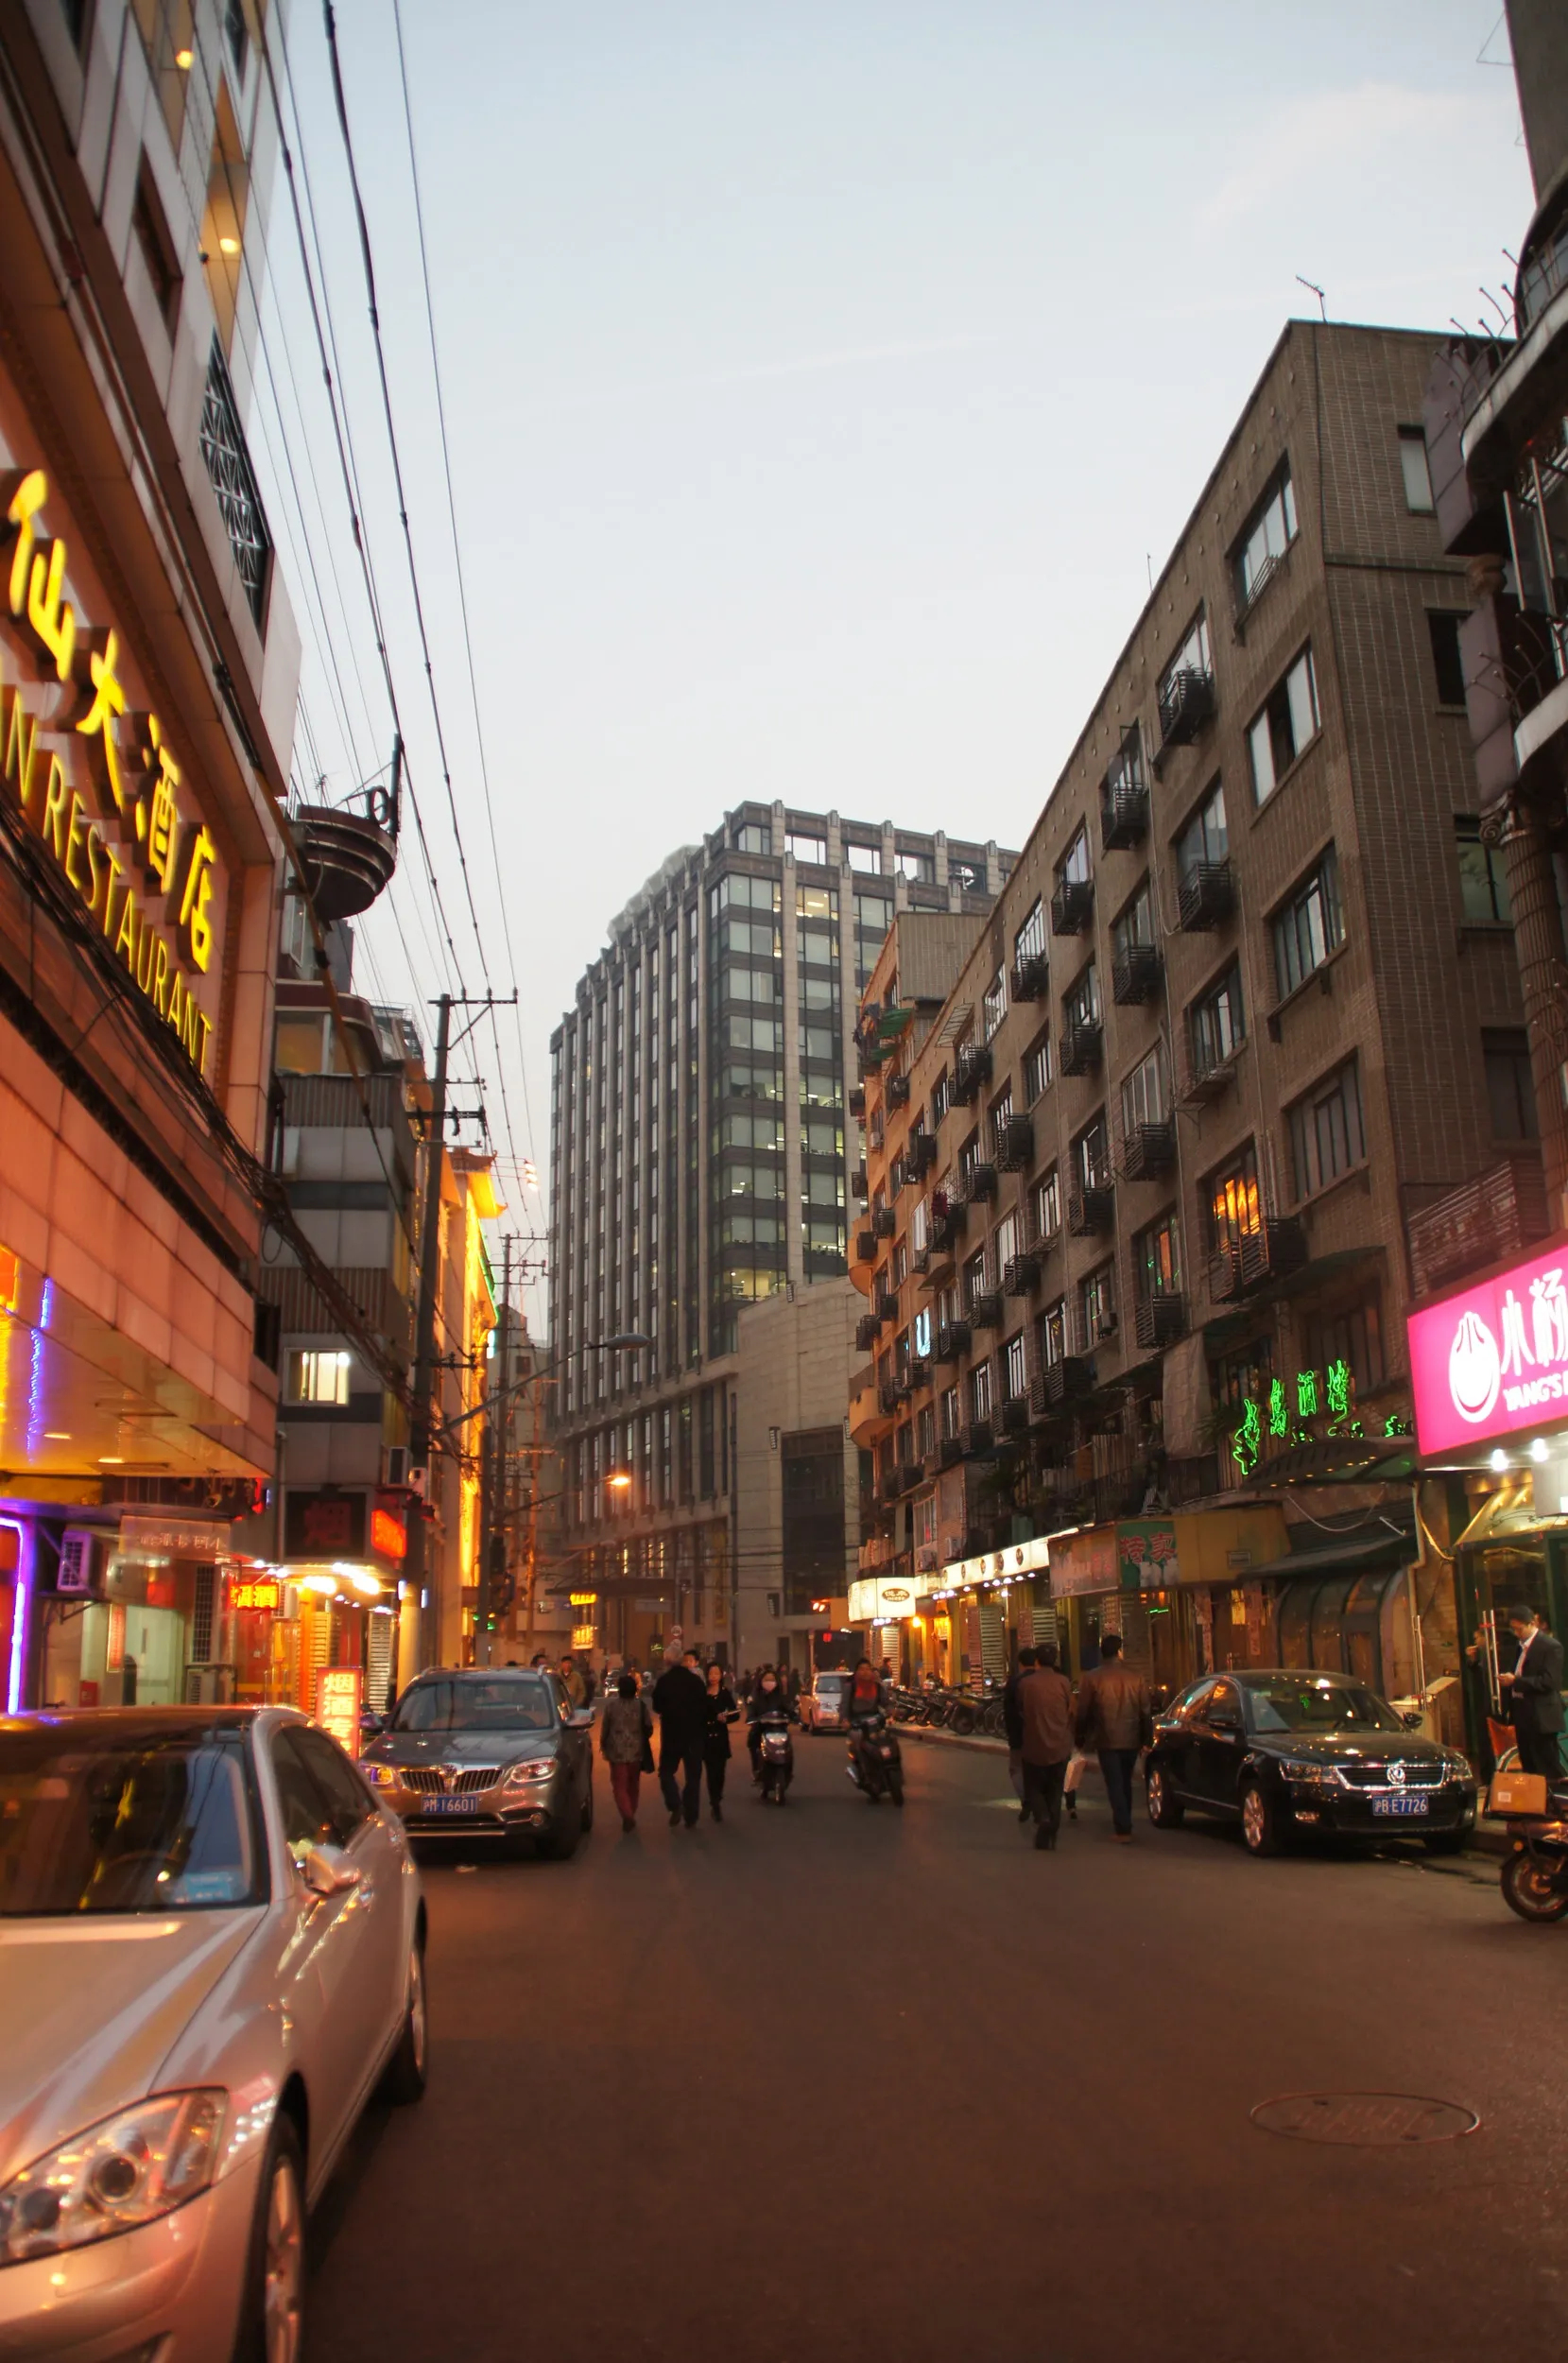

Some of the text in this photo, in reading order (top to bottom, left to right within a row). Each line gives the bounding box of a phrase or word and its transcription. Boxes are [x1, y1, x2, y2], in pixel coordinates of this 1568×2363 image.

[43, 753, 212, 1080] RESTAURANT
[1119, 1531, 1178, 1565] 特卖
[322, 1672, 356, 1753] 烟酒专
